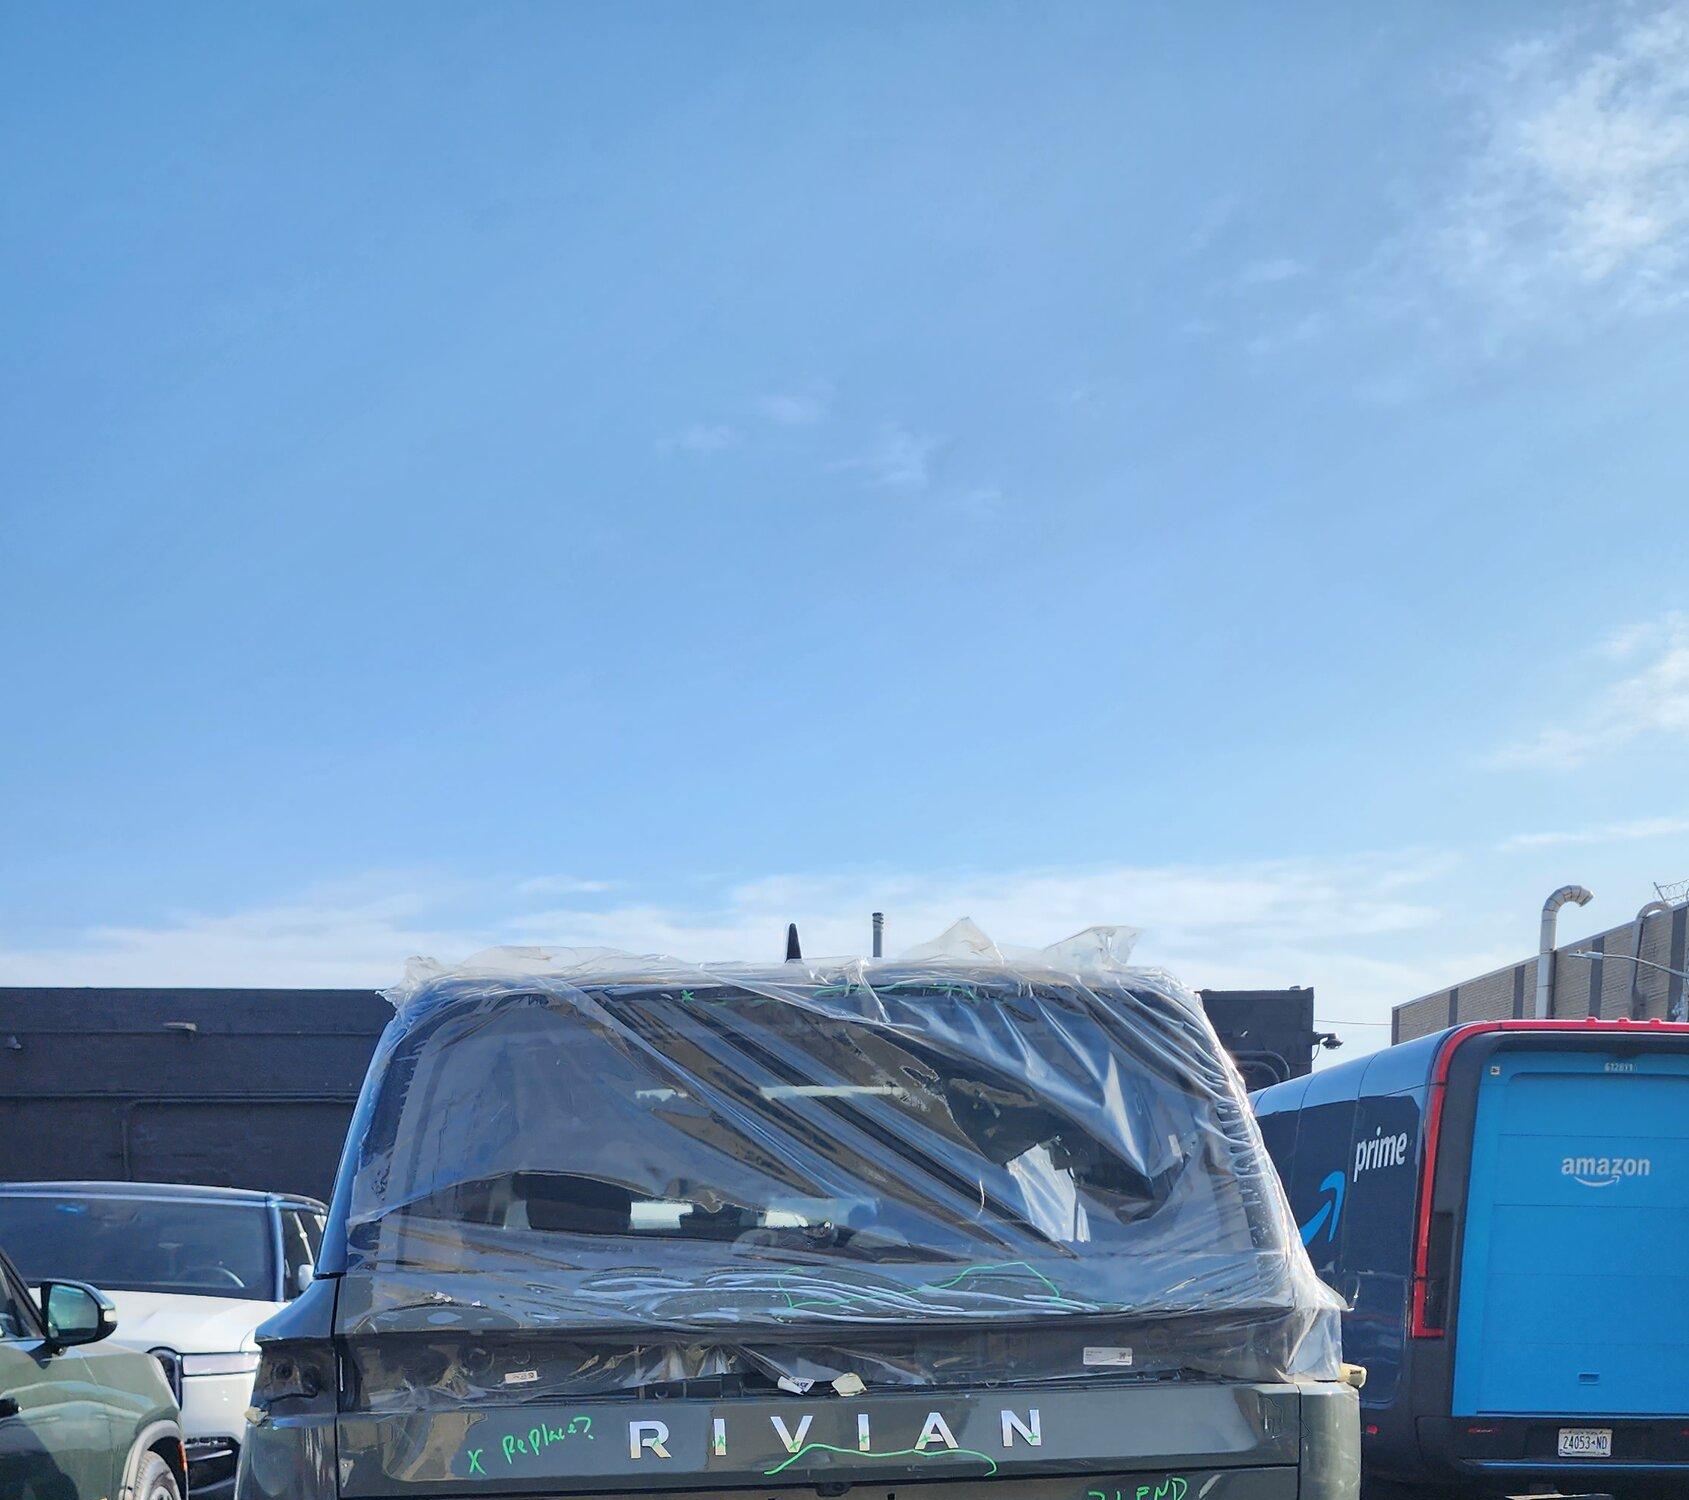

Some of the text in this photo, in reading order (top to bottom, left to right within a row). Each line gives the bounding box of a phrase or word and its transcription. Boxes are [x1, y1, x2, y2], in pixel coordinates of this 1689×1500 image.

[1353, 1126, 1408, 1182] prime
[1561, 1157, 1651, 1176] amazon
[629, 1409, 1042, 1460] RIVIAN
